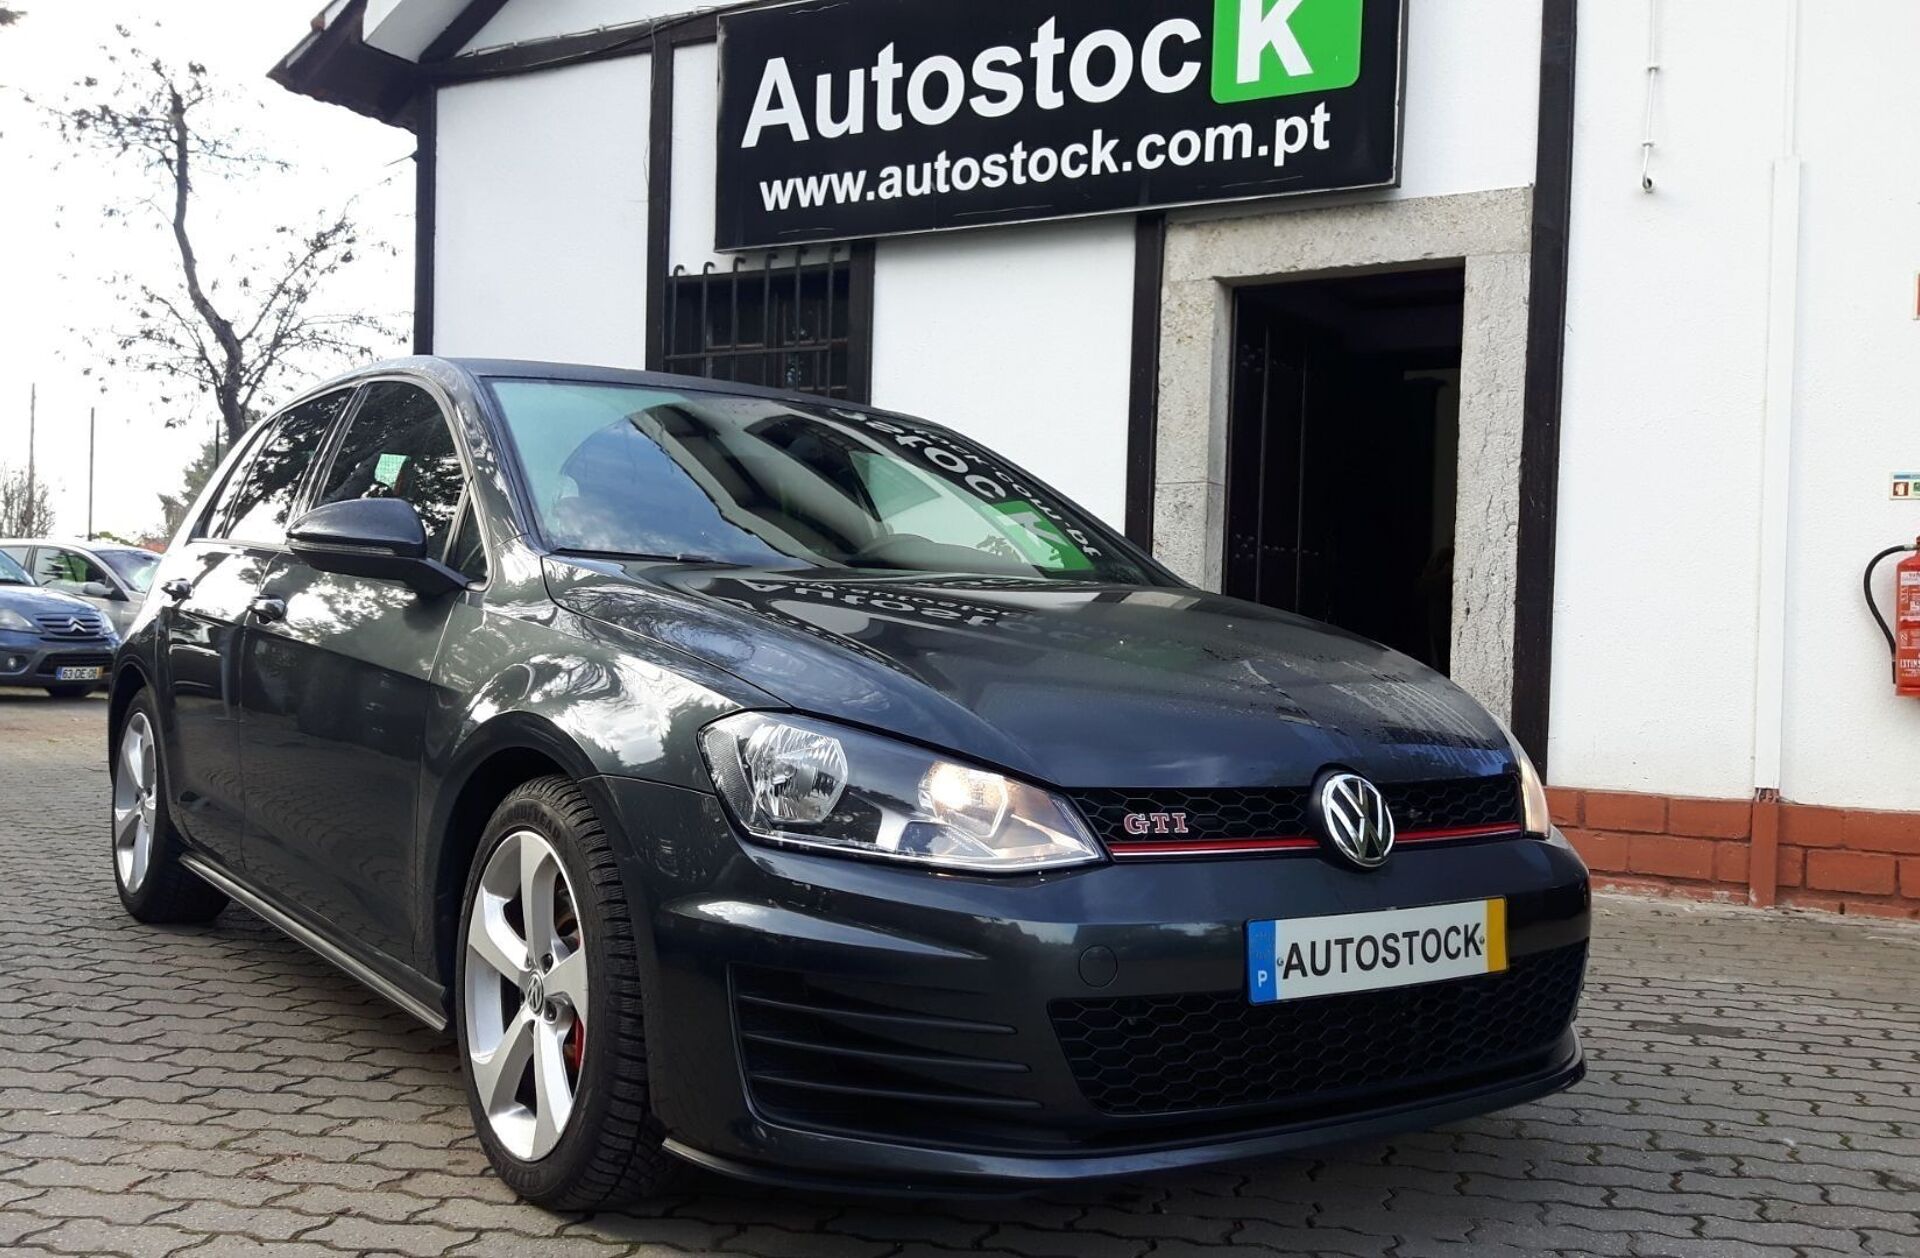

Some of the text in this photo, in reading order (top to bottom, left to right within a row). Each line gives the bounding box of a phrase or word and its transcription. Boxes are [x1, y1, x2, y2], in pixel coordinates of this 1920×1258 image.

[760, 102, 1330, 212] www.autostock.com.pt
[1123, 812, 1189, 834] GTI
[1281, 922, 1482, 980] AUTOSTOCK
[1257, 969, 1268, 988] P
